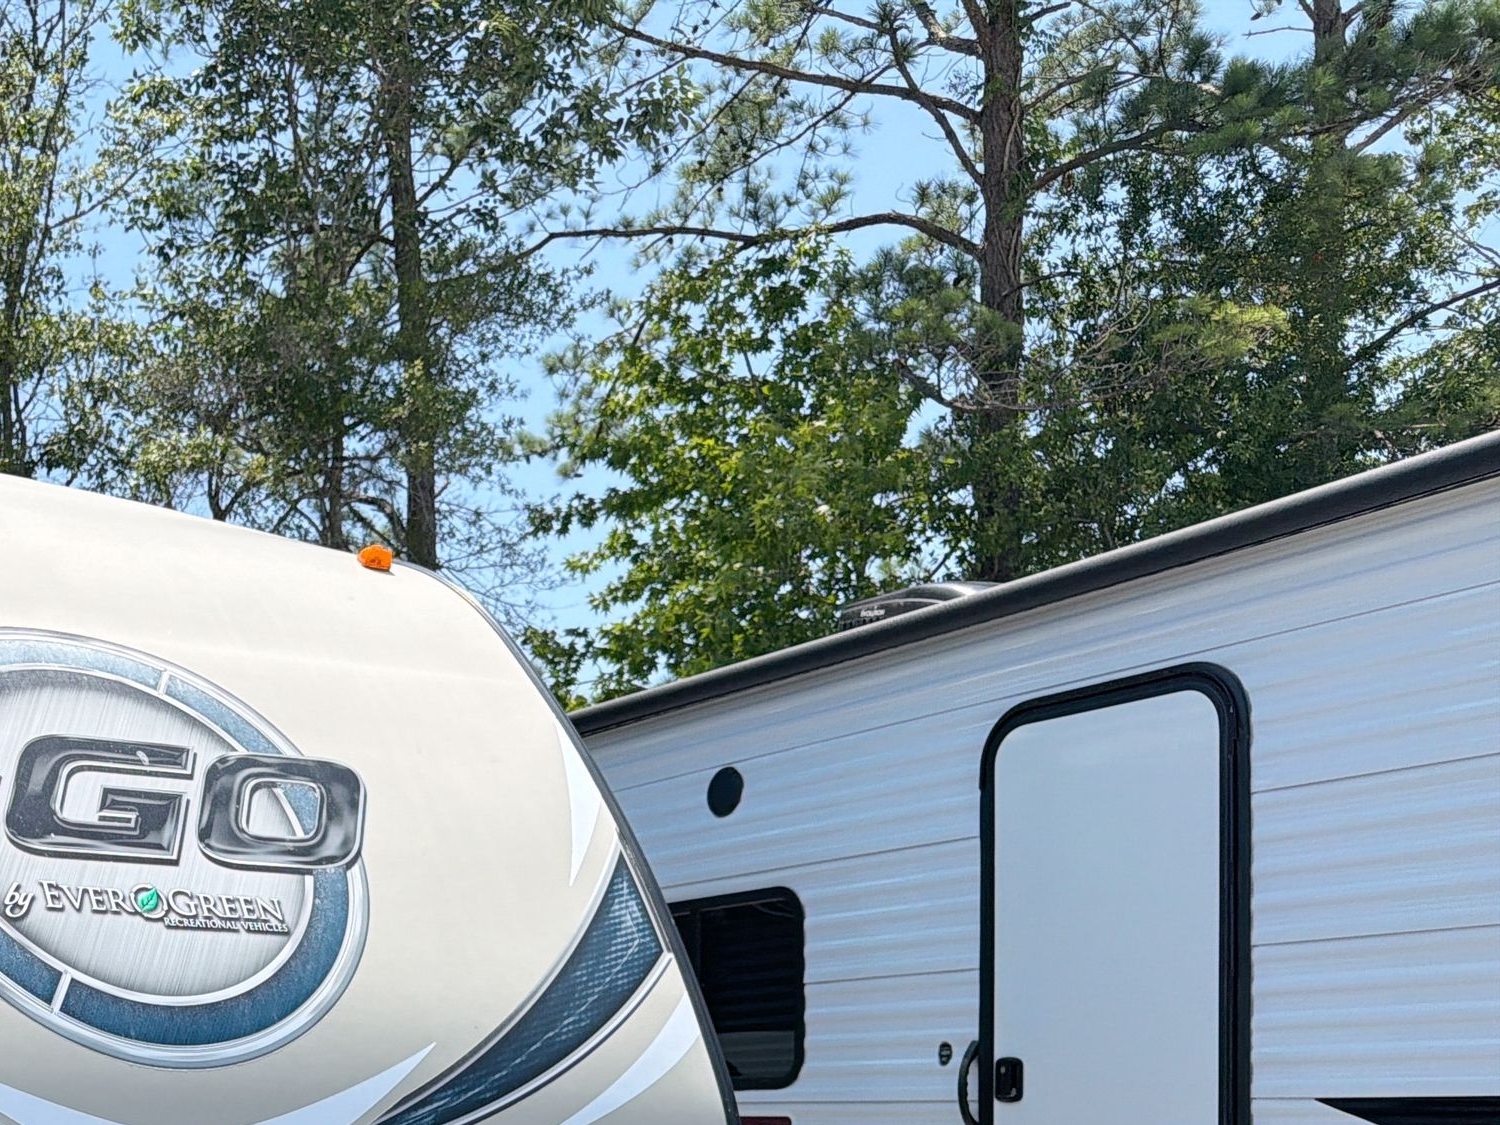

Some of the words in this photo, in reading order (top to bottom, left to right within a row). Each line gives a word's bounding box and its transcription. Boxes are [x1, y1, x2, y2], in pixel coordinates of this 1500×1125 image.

[3, 881, 34, 919] by
[164, 916, 239, 931] RECREATIONAL
[240, 920, 290, 933] VEHICLES
